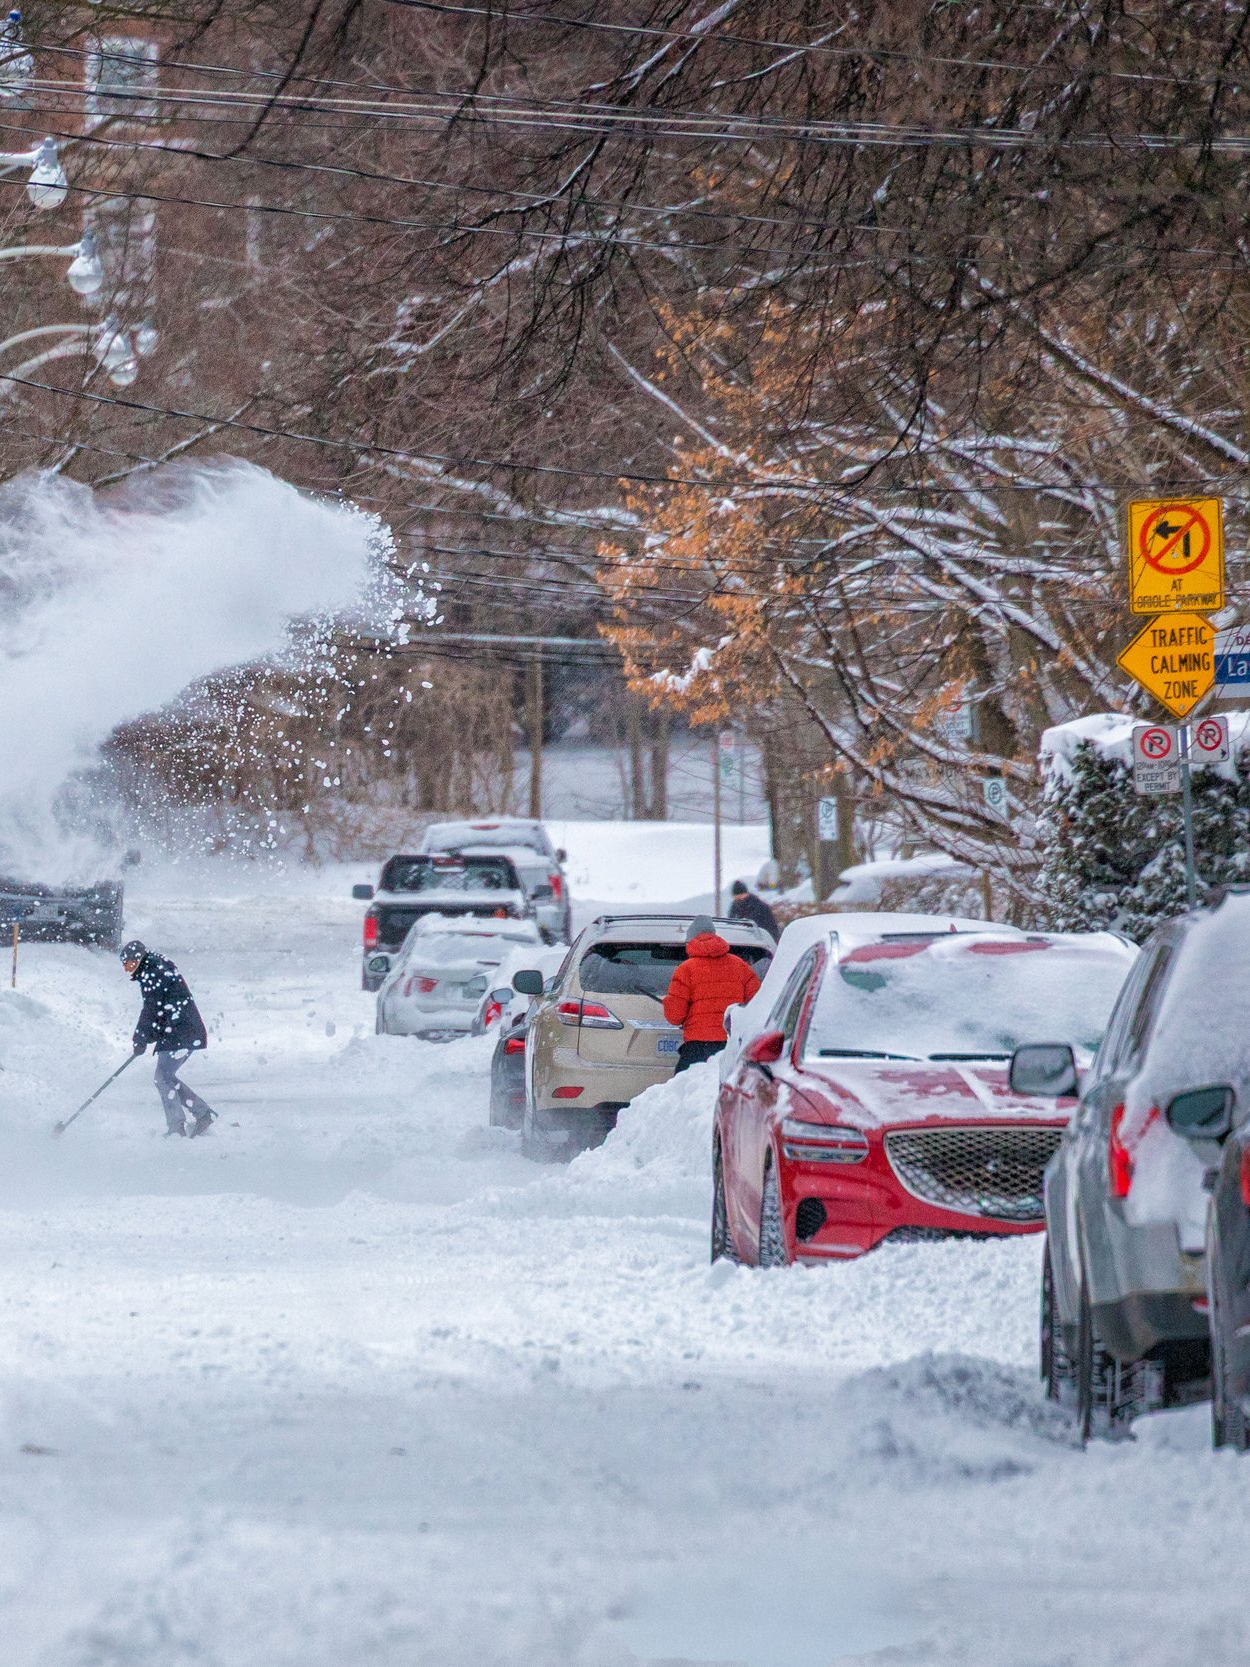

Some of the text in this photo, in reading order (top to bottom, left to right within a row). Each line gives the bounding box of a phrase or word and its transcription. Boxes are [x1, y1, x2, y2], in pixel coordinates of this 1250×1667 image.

[1171, 579, 1183, 591] AT
[1176, 592, 1217, 607] PARKWAY
[1151, 626, 1208, 648] TRAFFIC
[1151, 653, 1210, 675] CALMING
[1164, 680, 1199, 700] ZONE
[1137, 771, 1177, 783] EXCEPT BY
[1145, 781, 1171, 792] PERMIT
